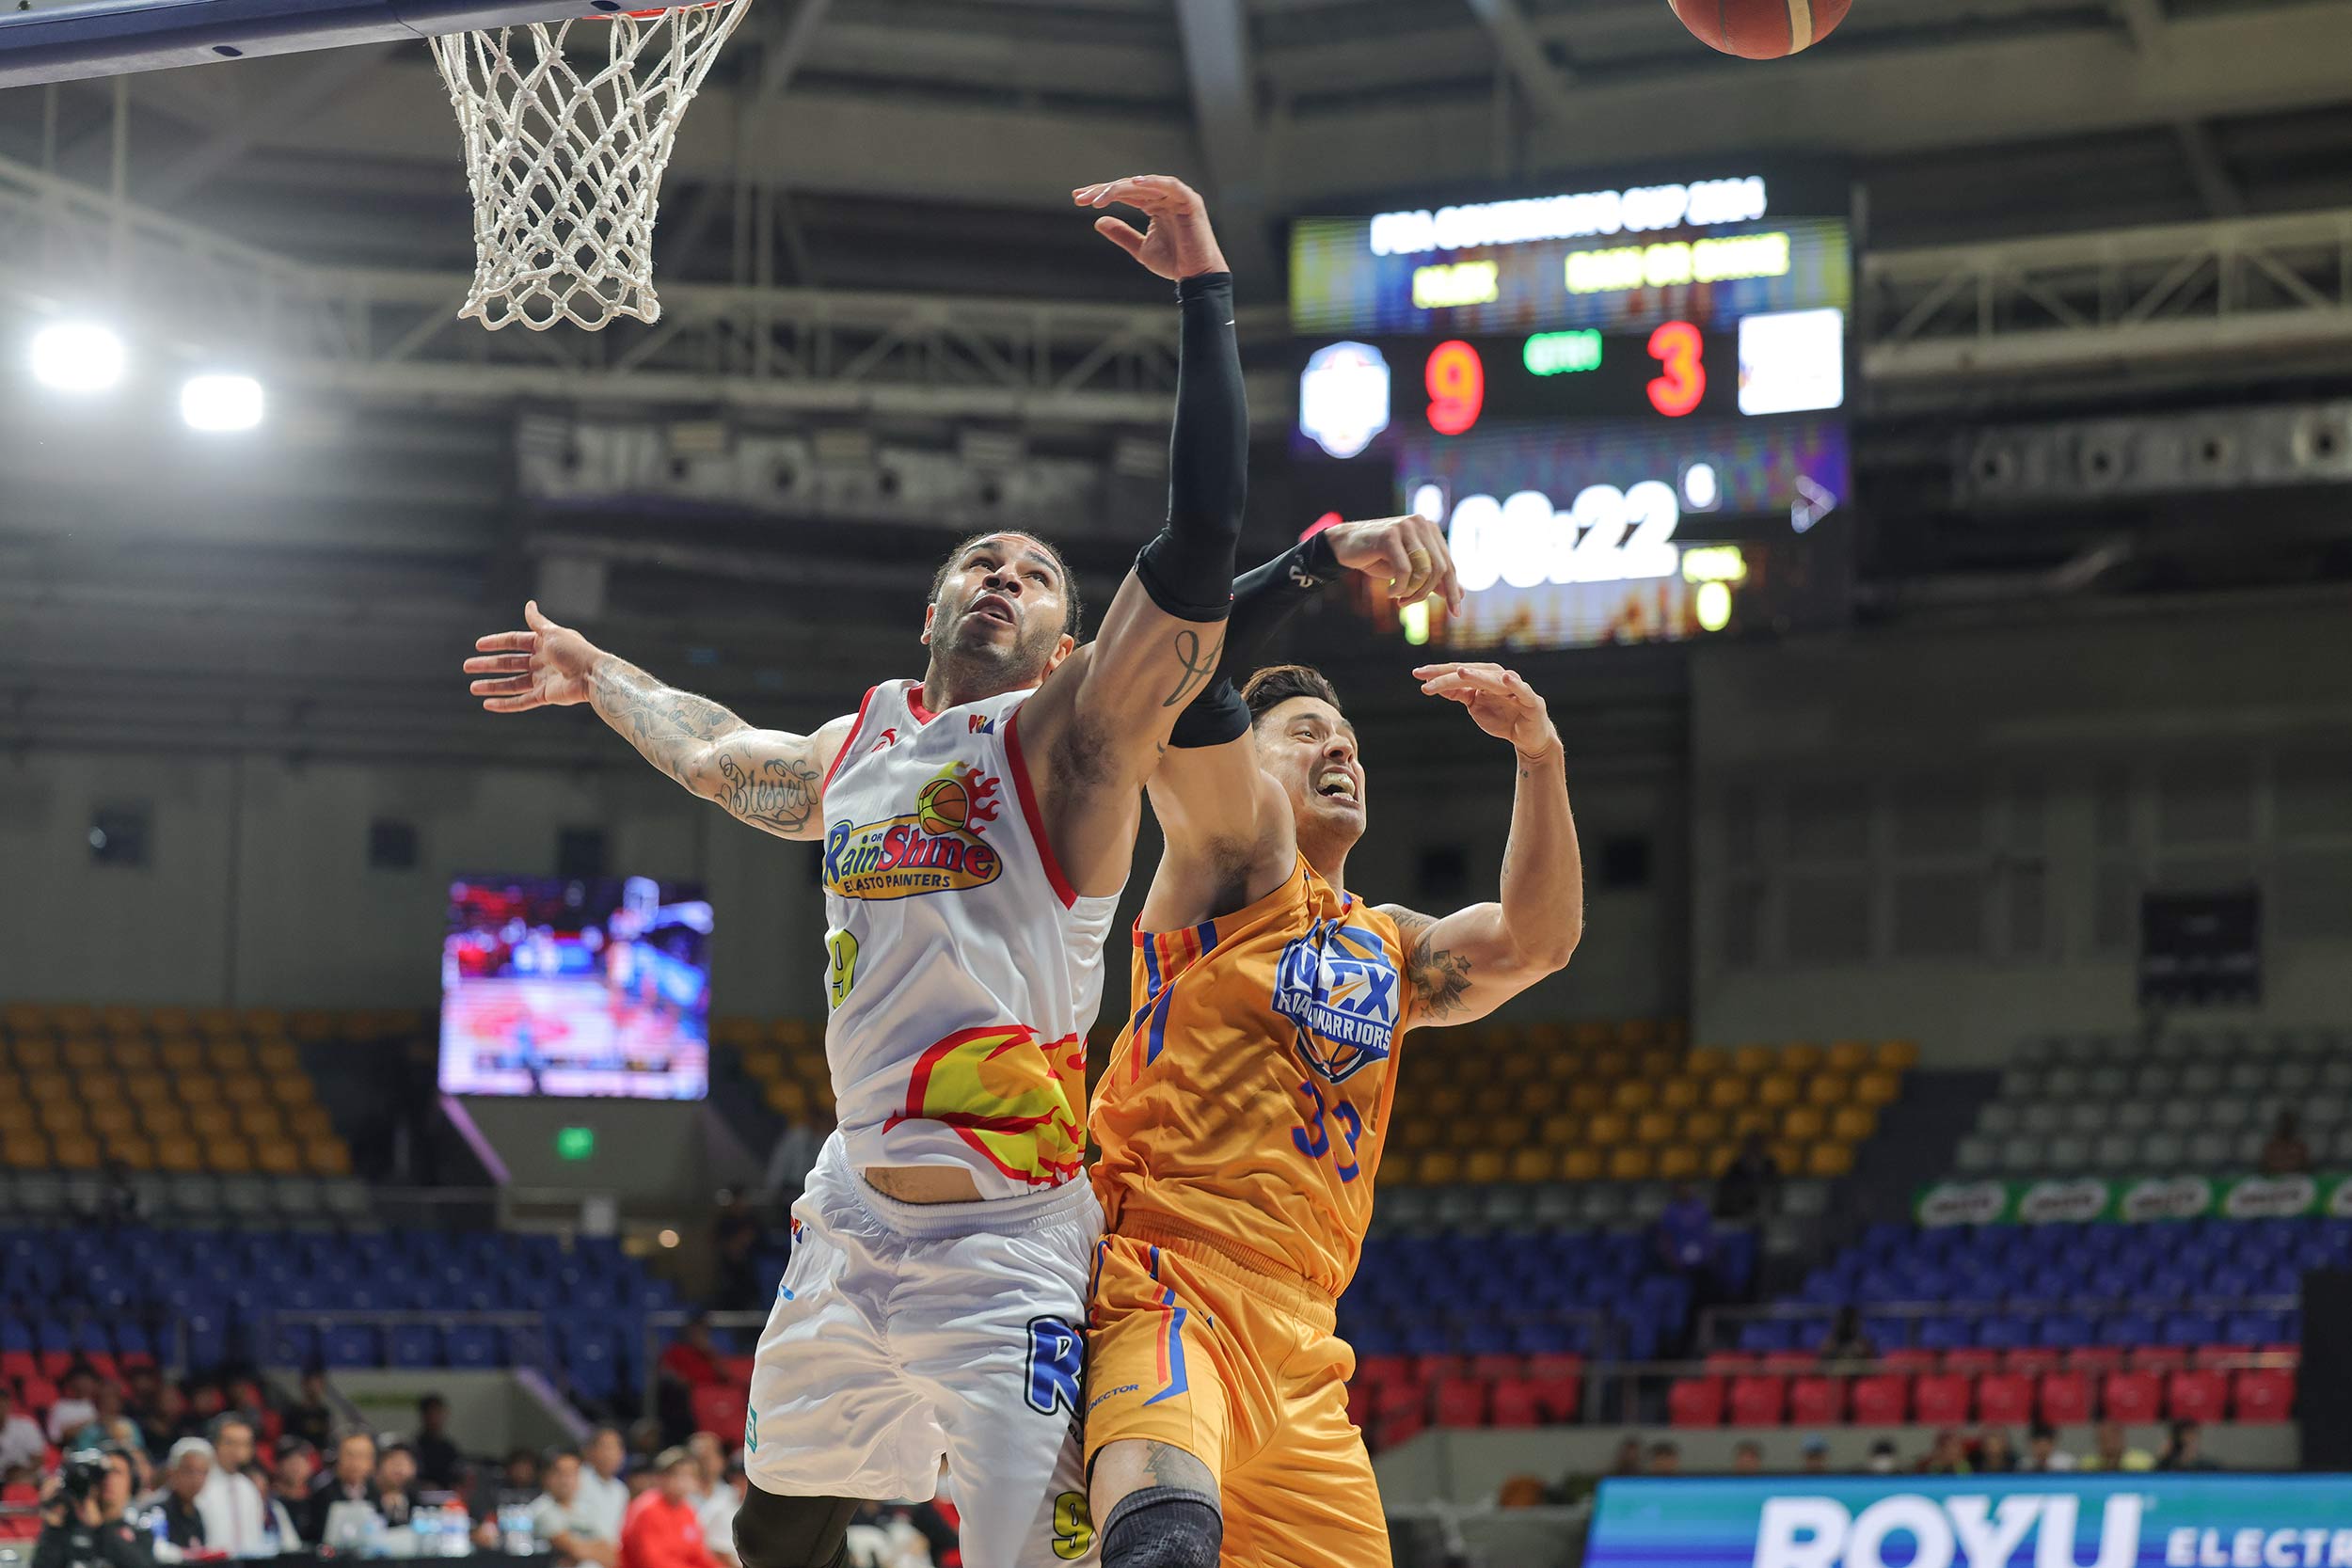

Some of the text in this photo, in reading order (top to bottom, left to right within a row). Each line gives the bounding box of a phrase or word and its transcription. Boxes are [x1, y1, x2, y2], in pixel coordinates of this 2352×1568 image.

[1425, 341, 1484, 435] 9
[1647, 321, 1706, 417] 3
[823, 819, 995, 887] Rain OR Shine
[886, 873, 951, 888] PAINTERS
[829, 928, 859, 1010] 9
[1312, 1007, 1391, 1053] WARRIORS
[1291, 1079, 1362, 1183] 33
[1052, 1491, 1094, 1560] 9
[1753, 1493, 2142, 1568] ROYU
